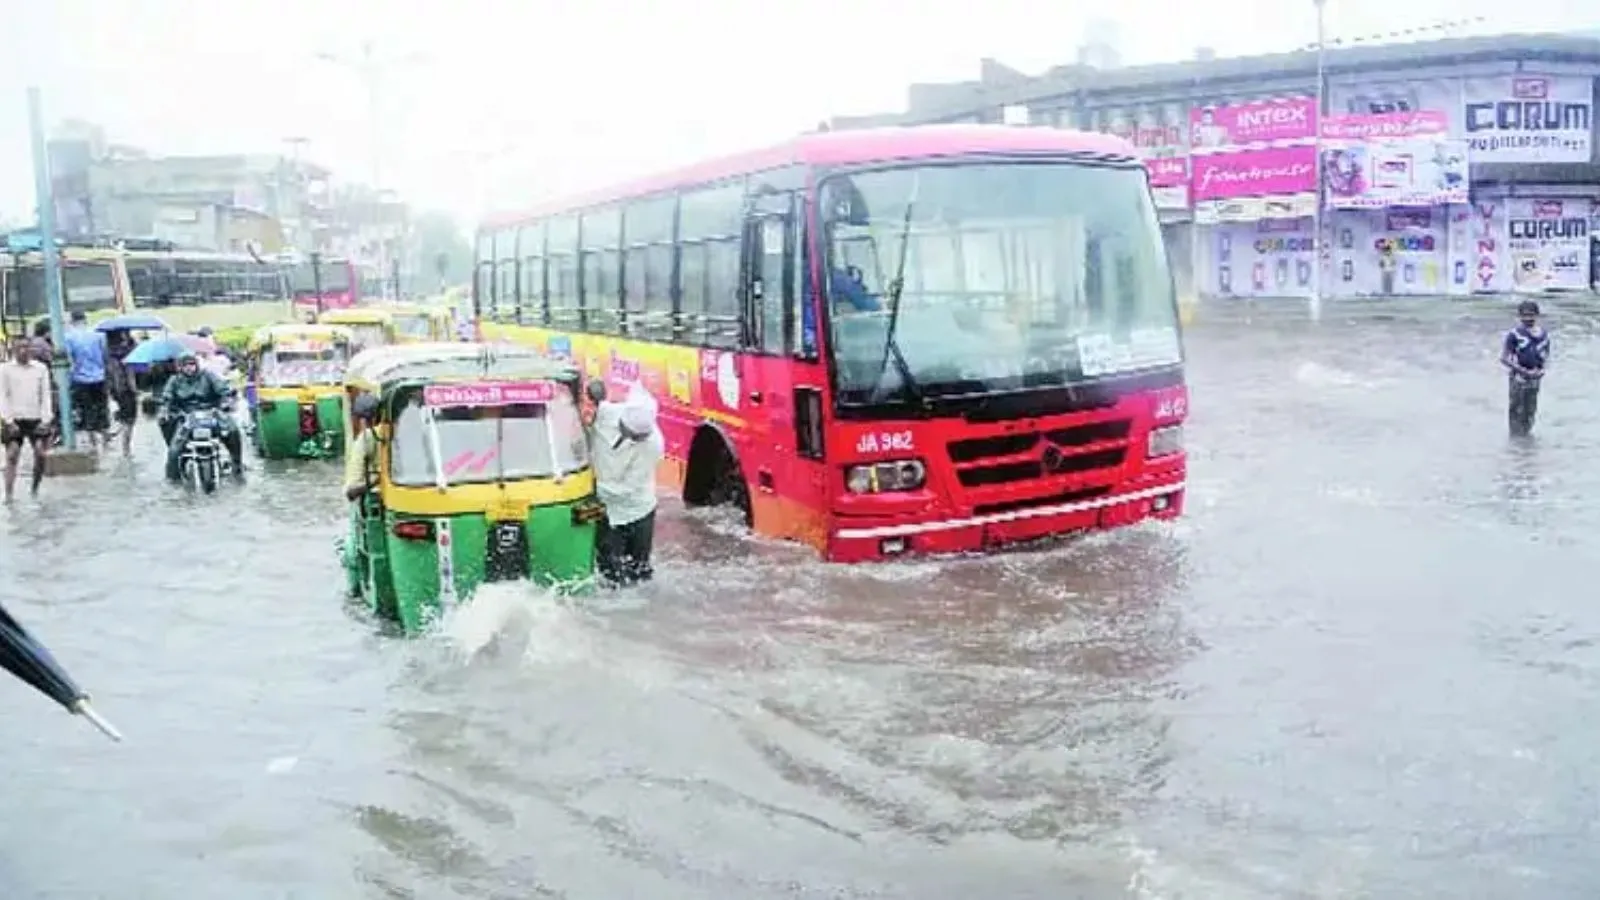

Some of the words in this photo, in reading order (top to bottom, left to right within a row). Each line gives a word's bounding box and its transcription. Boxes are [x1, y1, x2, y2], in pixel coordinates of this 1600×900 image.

[1466, 101, 1590, 132] CORUM
[1509, 218, 1587, 239] CORUM
[1477, 203, 1496, 287] VINAY
[855, 432, 879, 453] JA
